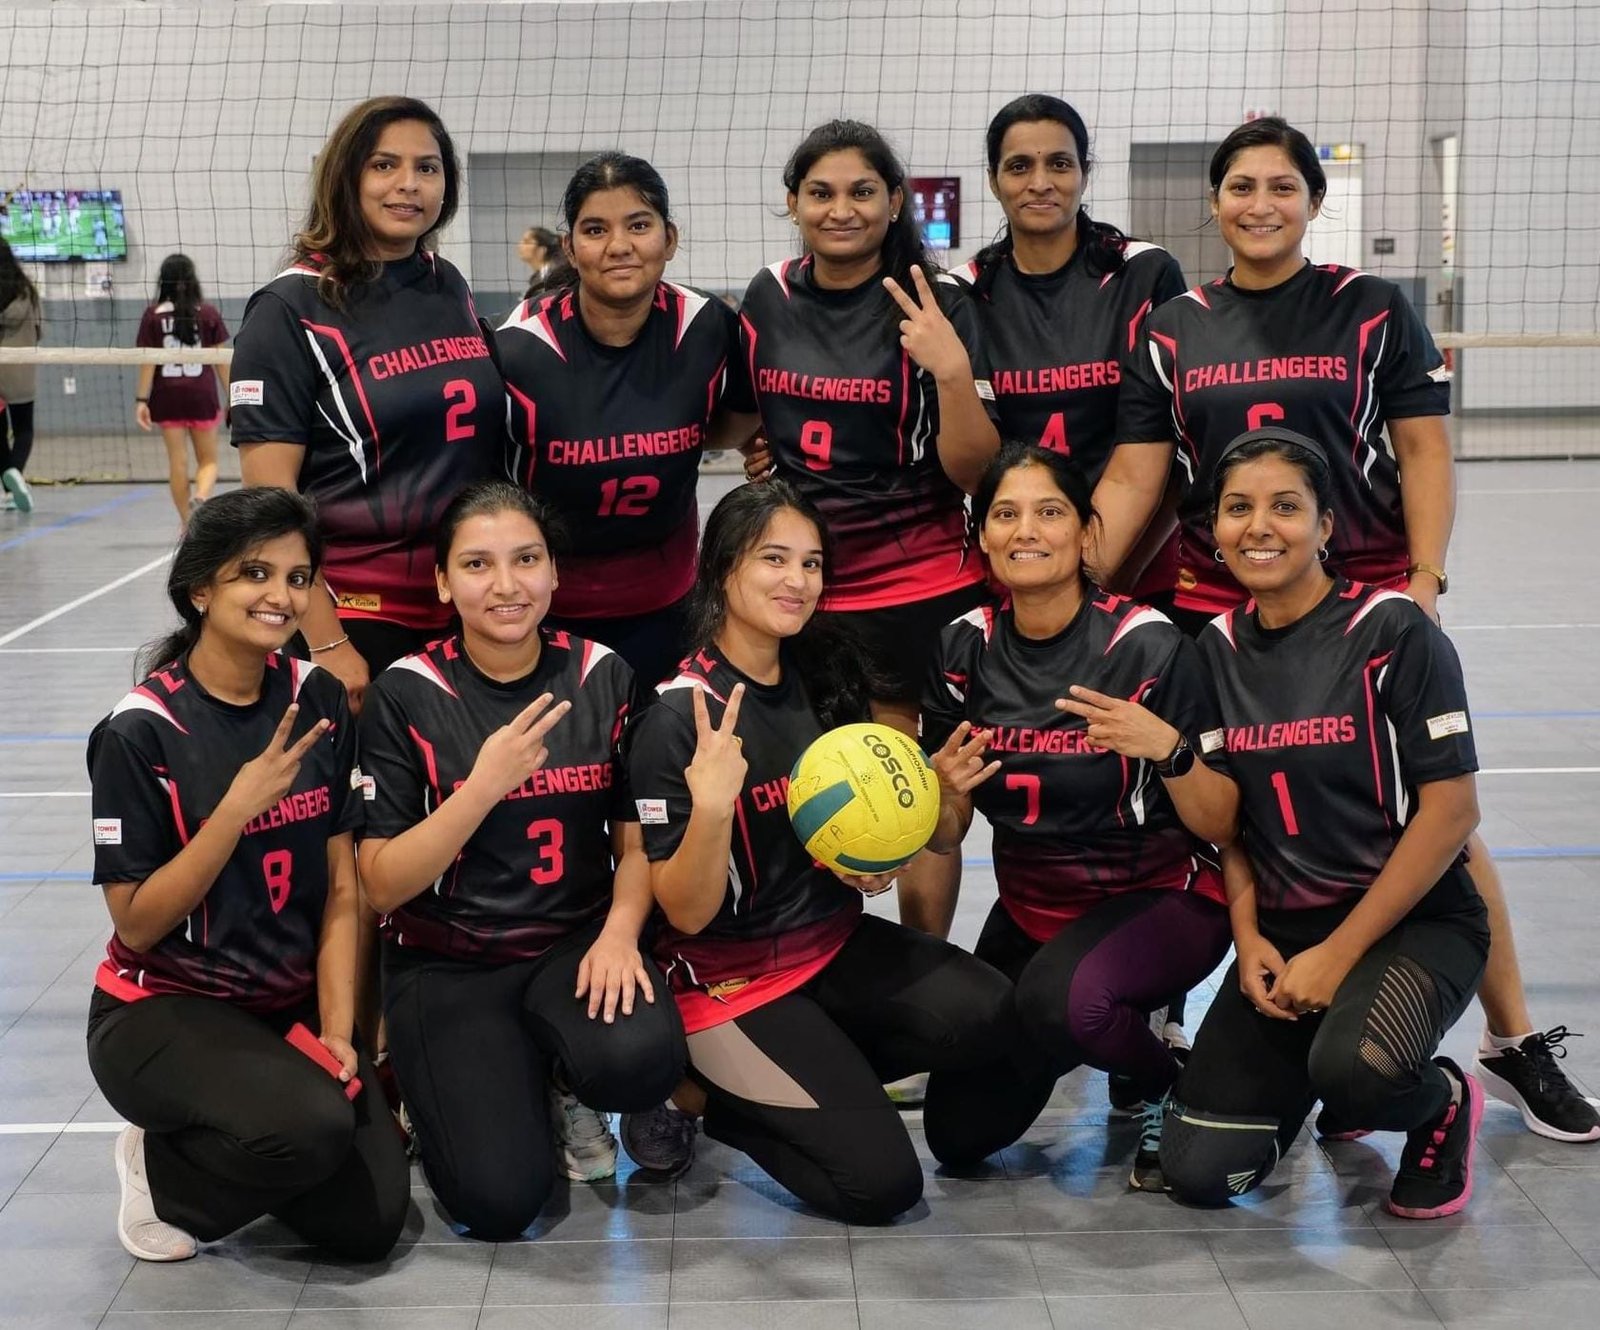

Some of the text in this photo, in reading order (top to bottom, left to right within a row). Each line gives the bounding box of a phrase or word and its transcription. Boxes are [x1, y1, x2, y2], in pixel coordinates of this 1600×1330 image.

[368, 336, 490, 381] CHALLENGERS
[992, 360, 1121, 395] HALLENGERS
[1184, 356, 1348, 393] CHALLENGERS
[759, 368, 892, 403] CHALLENGERS
[443, 379, 477, 442] 2
[1038, 412, 1071, 457] 4
[548, 423, 701, 465] CHALLENGERS
[801, 419, 833, 471] 9
[596, 475, 661, 516] 12
[1226, 715, 1356, 753] HALLENGERS
[862, 734, 915, 809] COSCO
[894, 735, 929, 792] CHAMPIONSHIP
[1006, 773, 1041, 825] 7
[1271, 771, 1300, 836] 1
[527, 817, 565, 886] 3
[262, 849, 293, 914] 8
